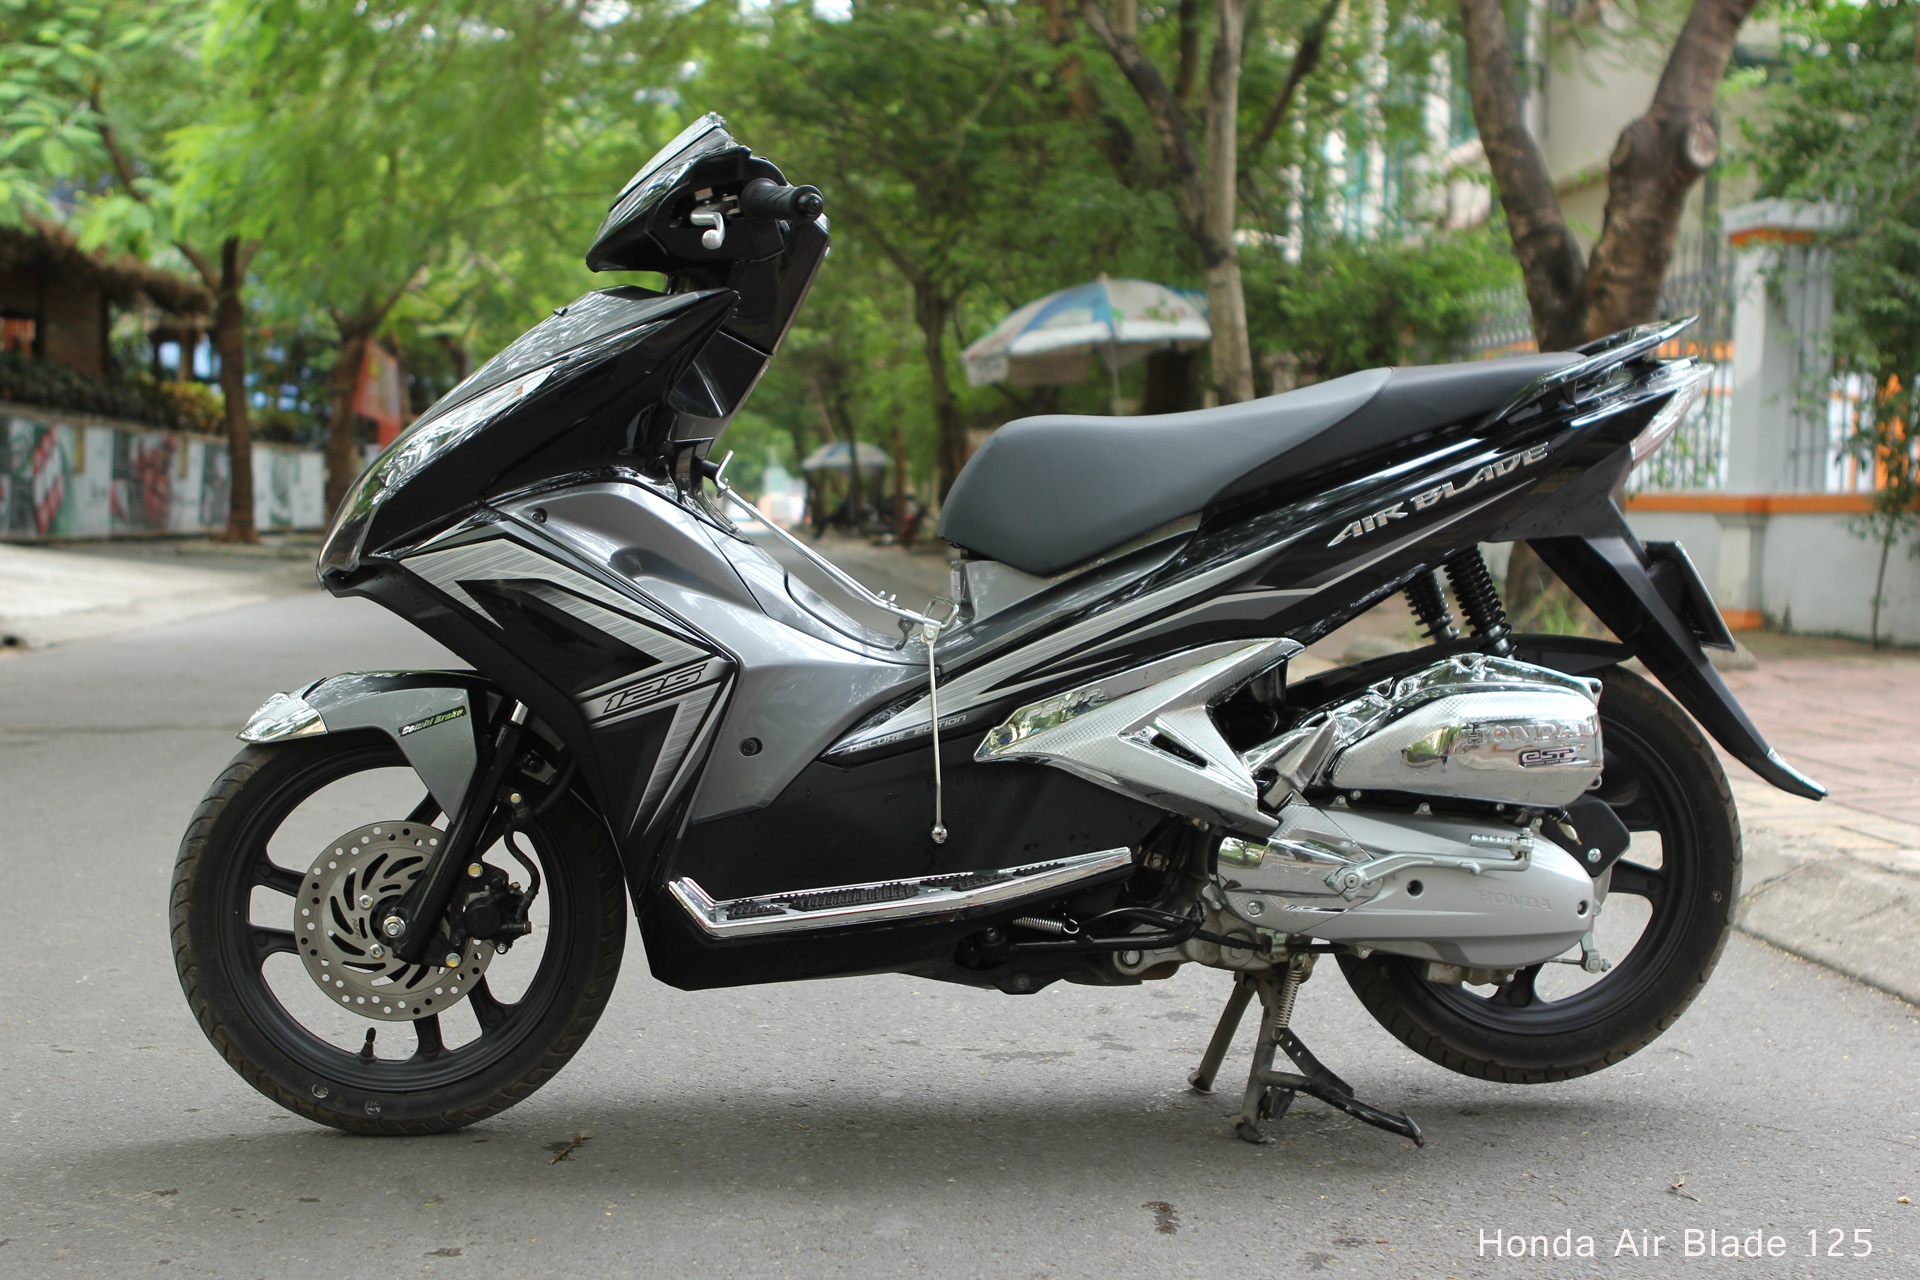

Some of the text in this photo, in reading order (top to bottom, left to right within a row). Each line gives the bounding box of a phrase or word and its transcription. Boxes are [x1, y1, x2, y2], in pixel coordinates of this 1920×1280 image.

[1327, 441, 1549, 547] AIR BLADE
[603, 662, 709, 713] 125
[914, 714, 967, 736] EDTION
